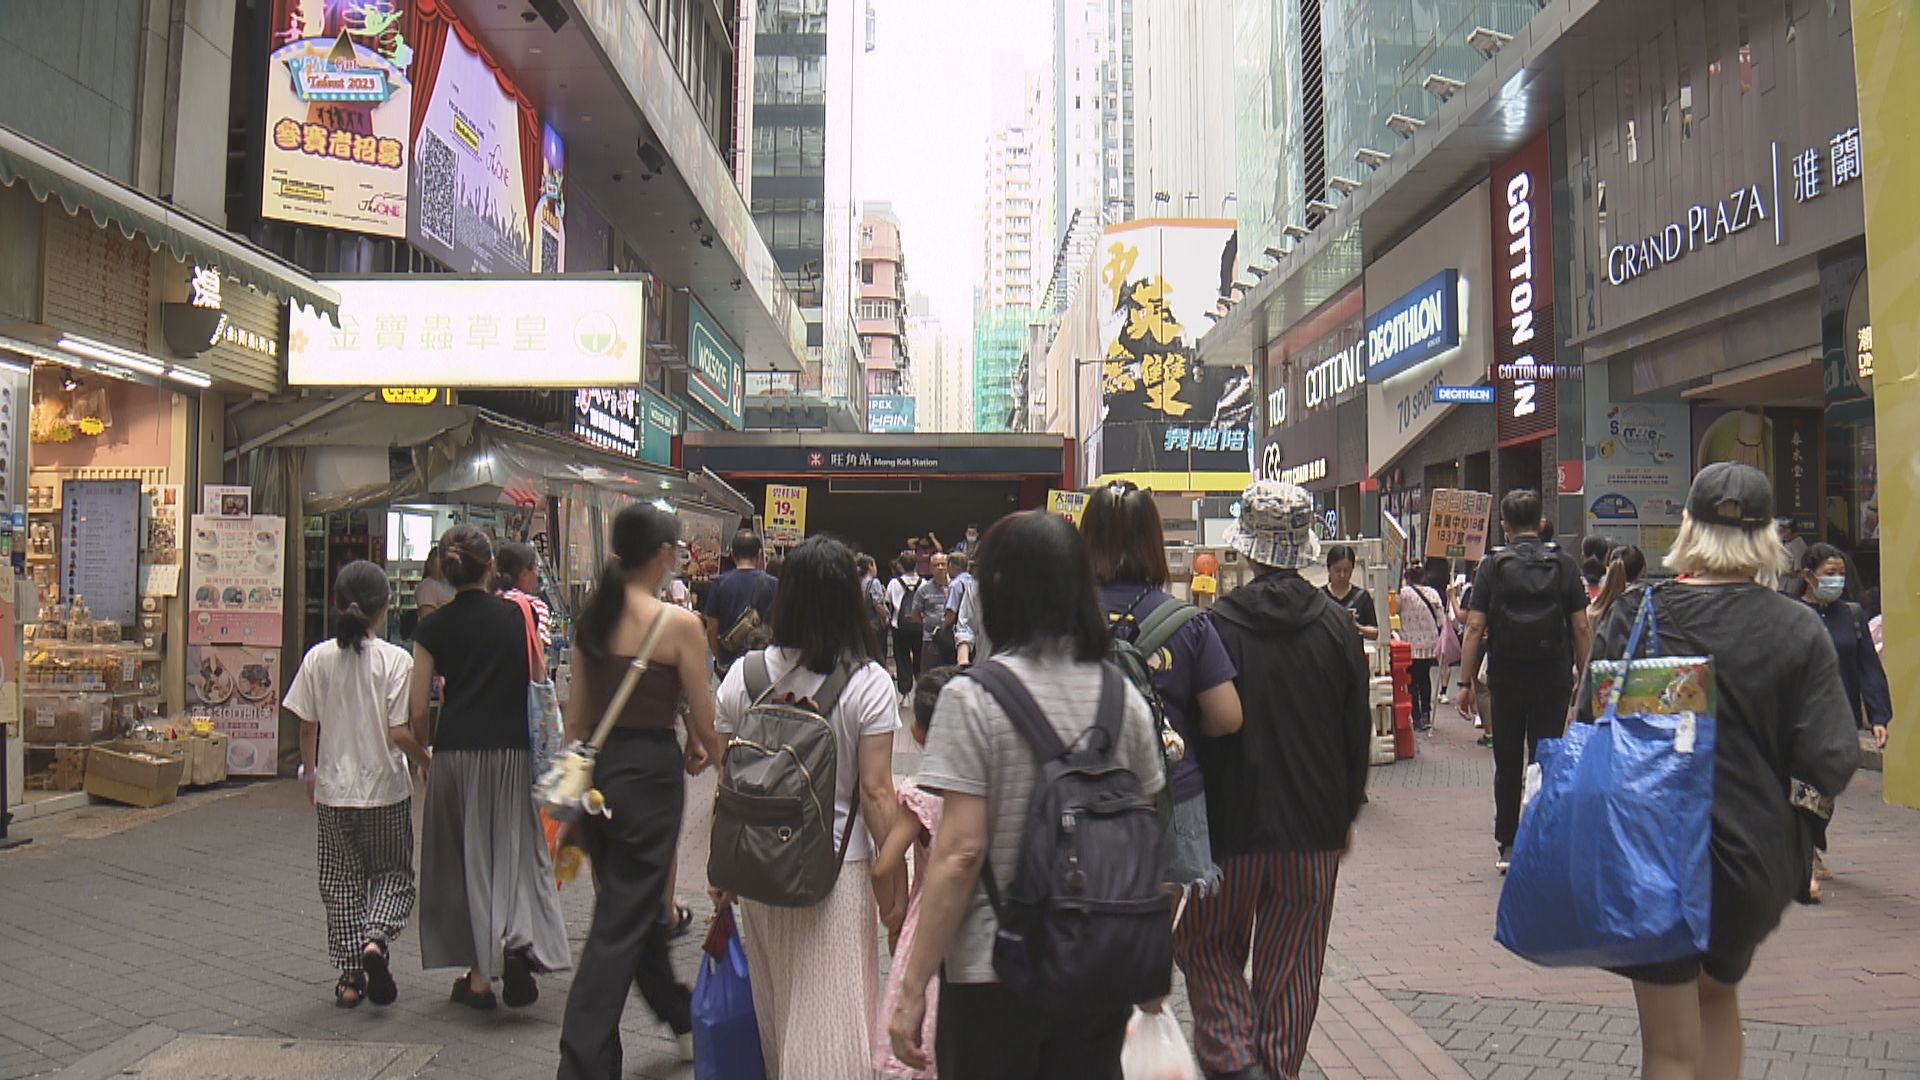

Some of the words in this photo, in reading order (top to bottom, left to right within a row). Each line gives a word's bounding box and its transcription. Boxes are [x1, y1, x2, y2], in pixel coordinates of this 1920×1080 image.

[347, 77, 375, 91] 2023
[1792, 128, 1861, 204] 雅蘭
[1608, 223, 1682, 286] GRAND
[1688, 184, 1766, 251] PLAZA
[1507, 171, 1535, 346] COTTON
[1368, 289, 1442, 368] DECATHLON
[1305, 345, 1355, 408] COTTON
[1499, 364, 1537, 379] COTTON
[1540, 364, 1553, 379] ON
[1439, 388, 1490, 400] DECATHLON
[1397, 395, 1411, 433] 70
[1164, 427, 1254, 451] 我哋陪
[830, 452, 872, 467] 旺角站
[873, 458, 896, 468] Mong
[896, 458, 911, 467] Kok
[912, 458, 938, 467] Station
